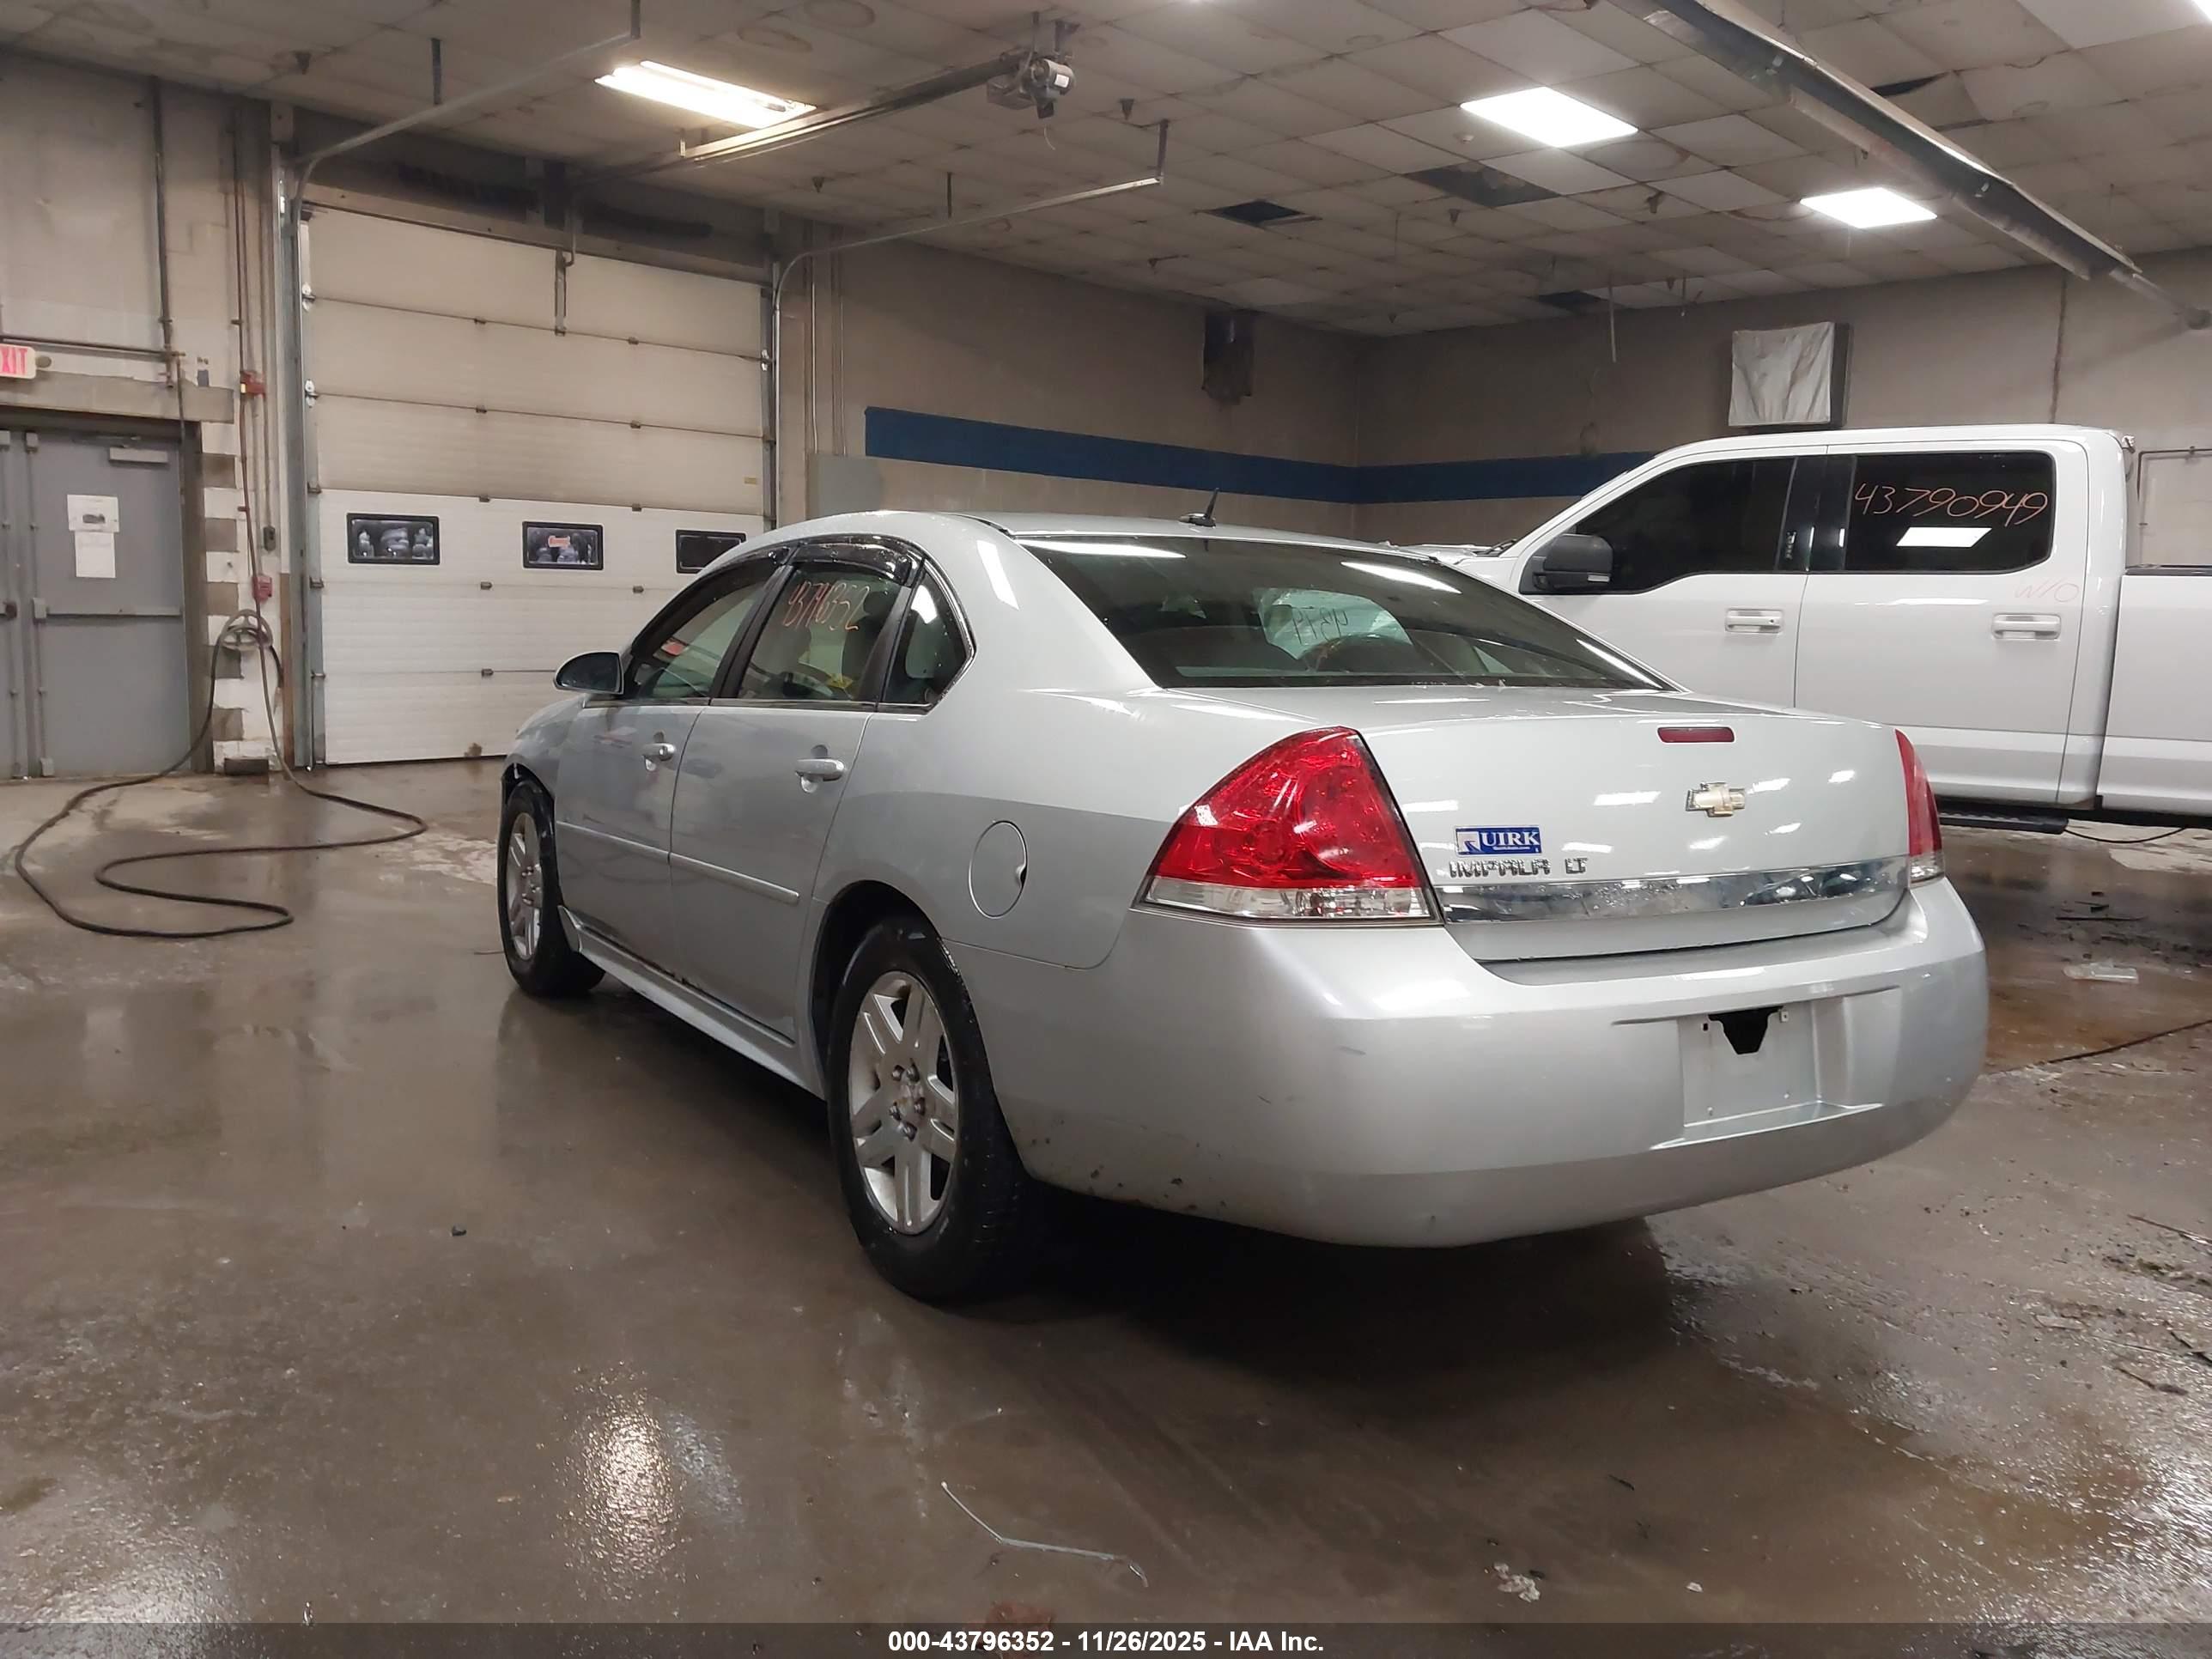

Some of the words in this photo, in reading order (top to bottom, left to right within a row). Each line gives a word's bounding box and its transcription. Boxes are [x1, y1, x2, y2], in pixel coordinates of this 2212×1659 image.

[0, 346, 28, 374] XIT
[1855, 483, 2047, 527] 43790949
[1449, 859, 1551, 878] IMPALA
